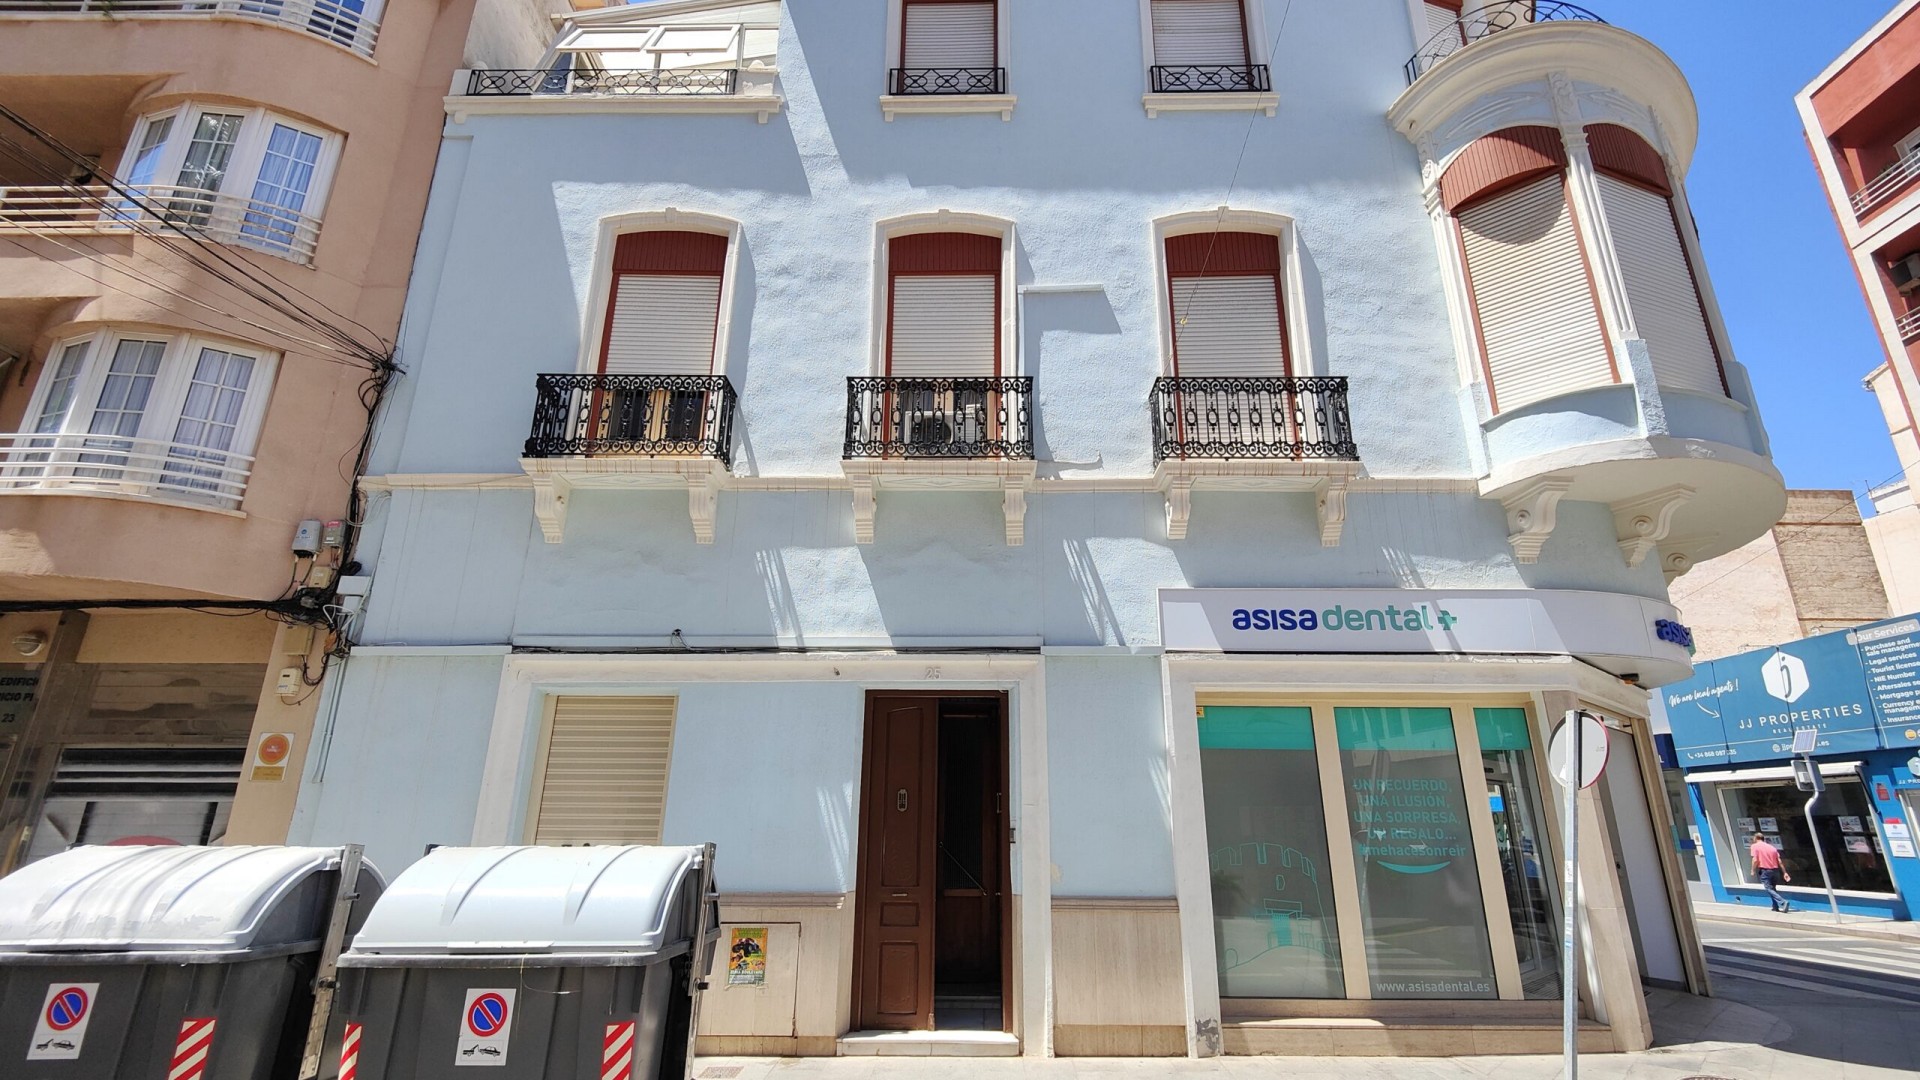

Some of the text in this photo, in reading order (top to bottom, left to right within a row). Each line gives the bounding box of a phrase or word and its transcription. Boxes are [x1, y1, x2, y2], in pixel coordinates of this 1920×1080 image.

[1232, 604, 1434, 631] asisa dental
[1855, 623, 1915, 642] Our Services
[1864, 637, 1911, 652] Purchase and
[1866, 642, 1920, 657] sale manageme
[1868, 652, 1917, 666] Legal services
[925, 666, 941, 680] 25
[1871, 665, 1895, 674] Tourist
[1874, 671, 1916, 683] NIE Number
[1877, 680, 1911, 691] Aftersales
[1668, 694, 1681, 708] We
[1879, 690, 1914, 700] Mortgage
[1882, 700, 1914, 709] Currency
[1884, 705, 1920, 714] managem
[1, 713, 16, 723] 23
[1739, 703, 1863, 730] JJ PROPERTIES
[1353, 778, 1372, 791] UN
[1361, 791, 1450, 809] UNA ILUSIÓN,
[1354, 810, 1461, 825] UNA SORPRESA,
[1367, 827, 1457, 841] UN REGALO...
[1376, 980, 1491, 993] www.asisadental.es
